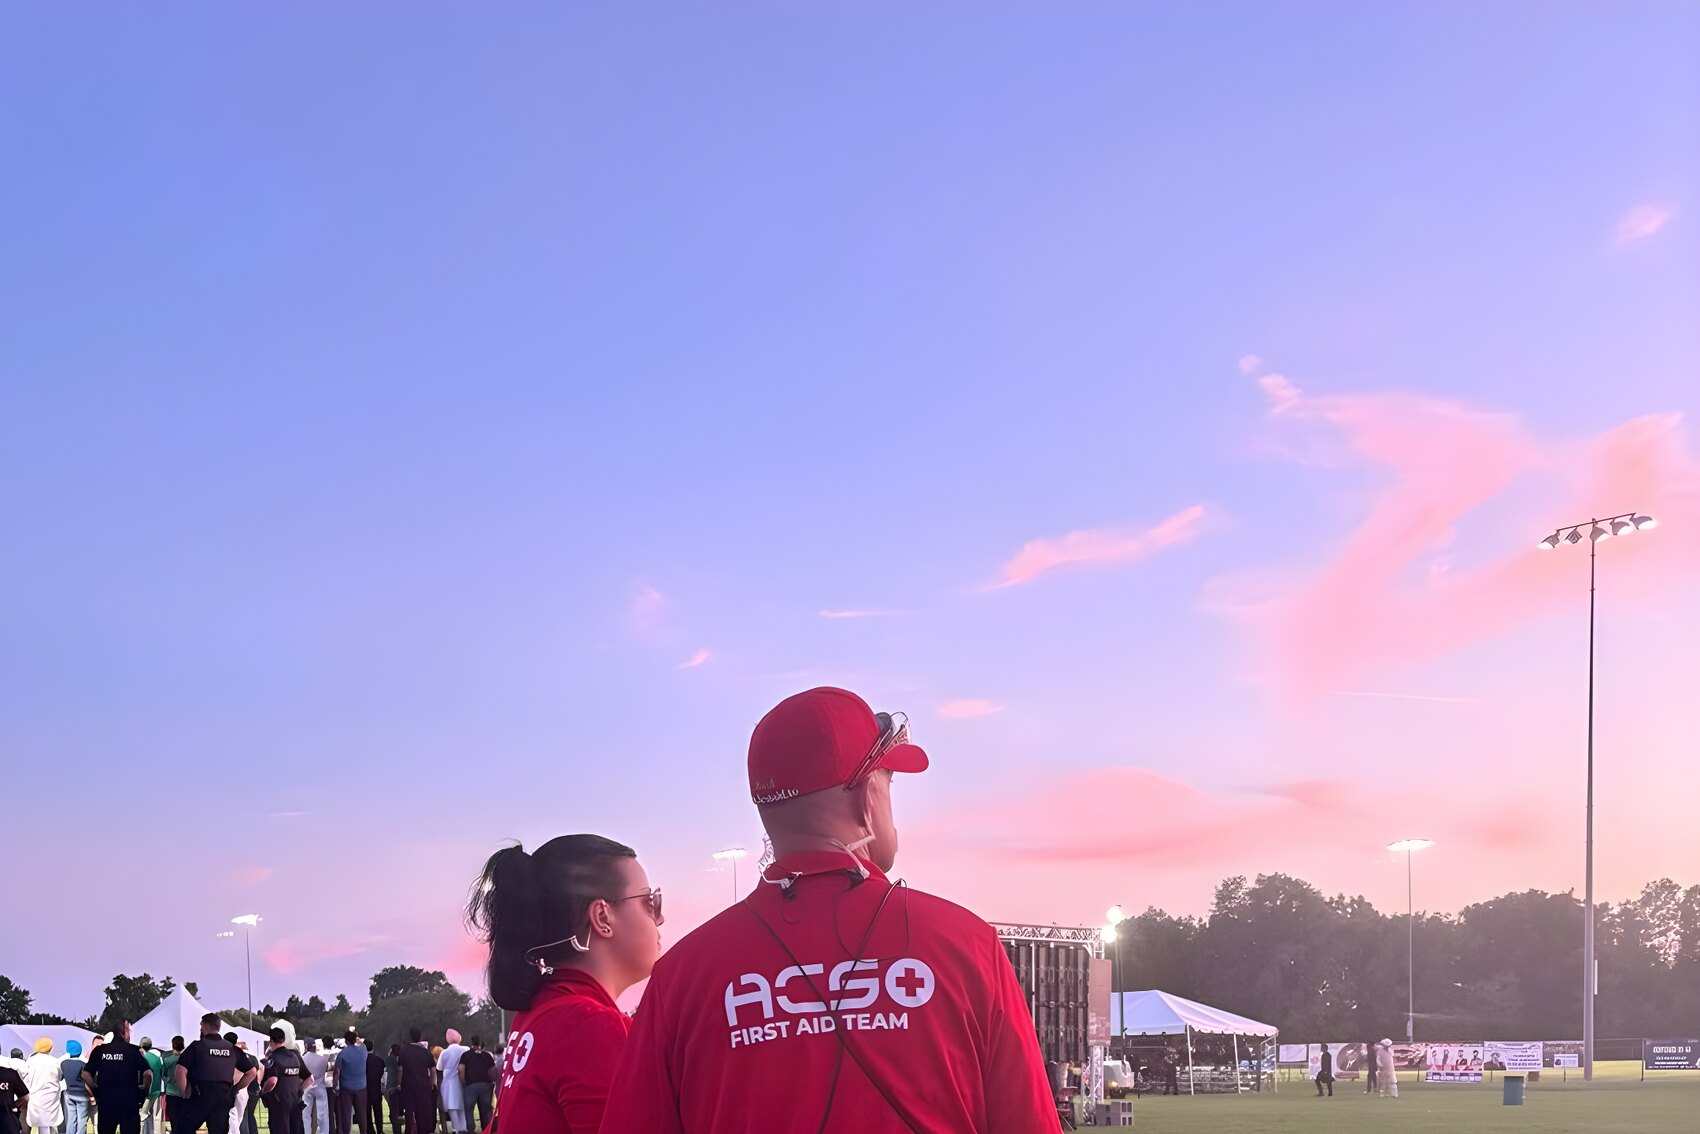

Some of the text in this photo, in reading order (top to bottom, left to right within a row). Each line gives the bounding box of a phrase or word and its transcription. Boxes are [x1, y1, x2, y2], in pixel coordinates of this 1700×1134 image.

[730, 1012, 908, 1048] FIRST AID TEAM
